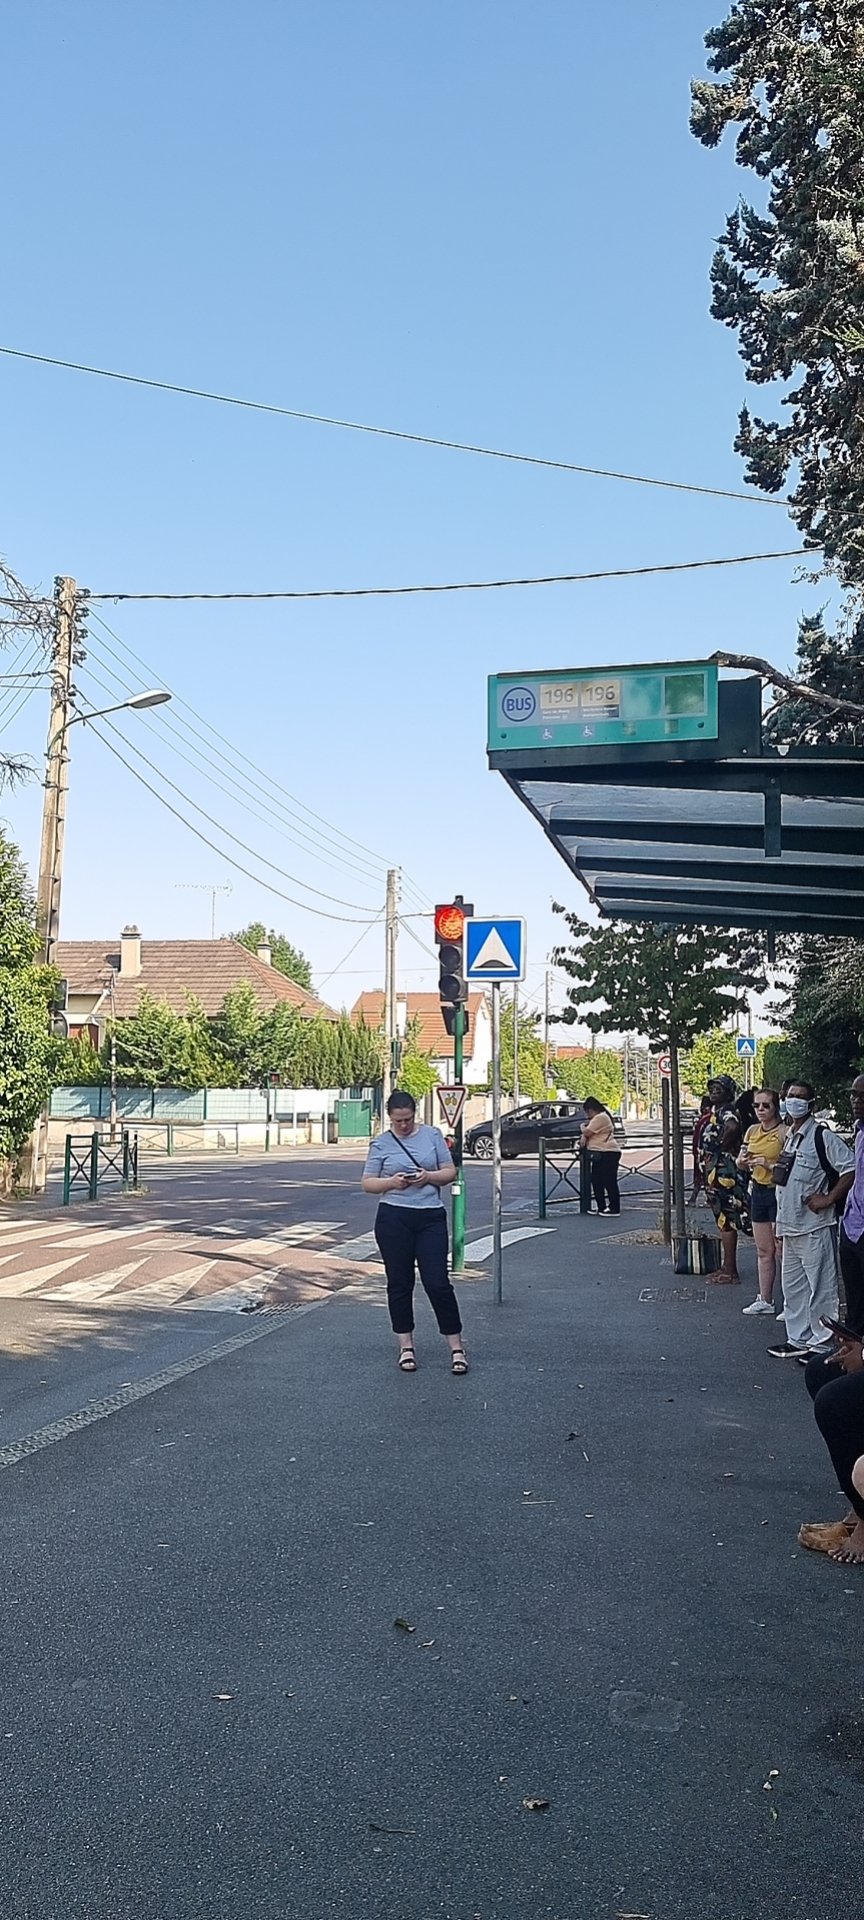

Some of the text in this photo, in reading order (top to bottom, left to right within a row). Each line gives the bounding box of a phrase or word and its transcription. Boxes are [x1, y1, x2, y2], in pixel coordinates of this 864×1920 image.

[544, 687, 574, 704] 196
[586, 685, 616, 701] 196
[506, 697, 532, 712] BUS
